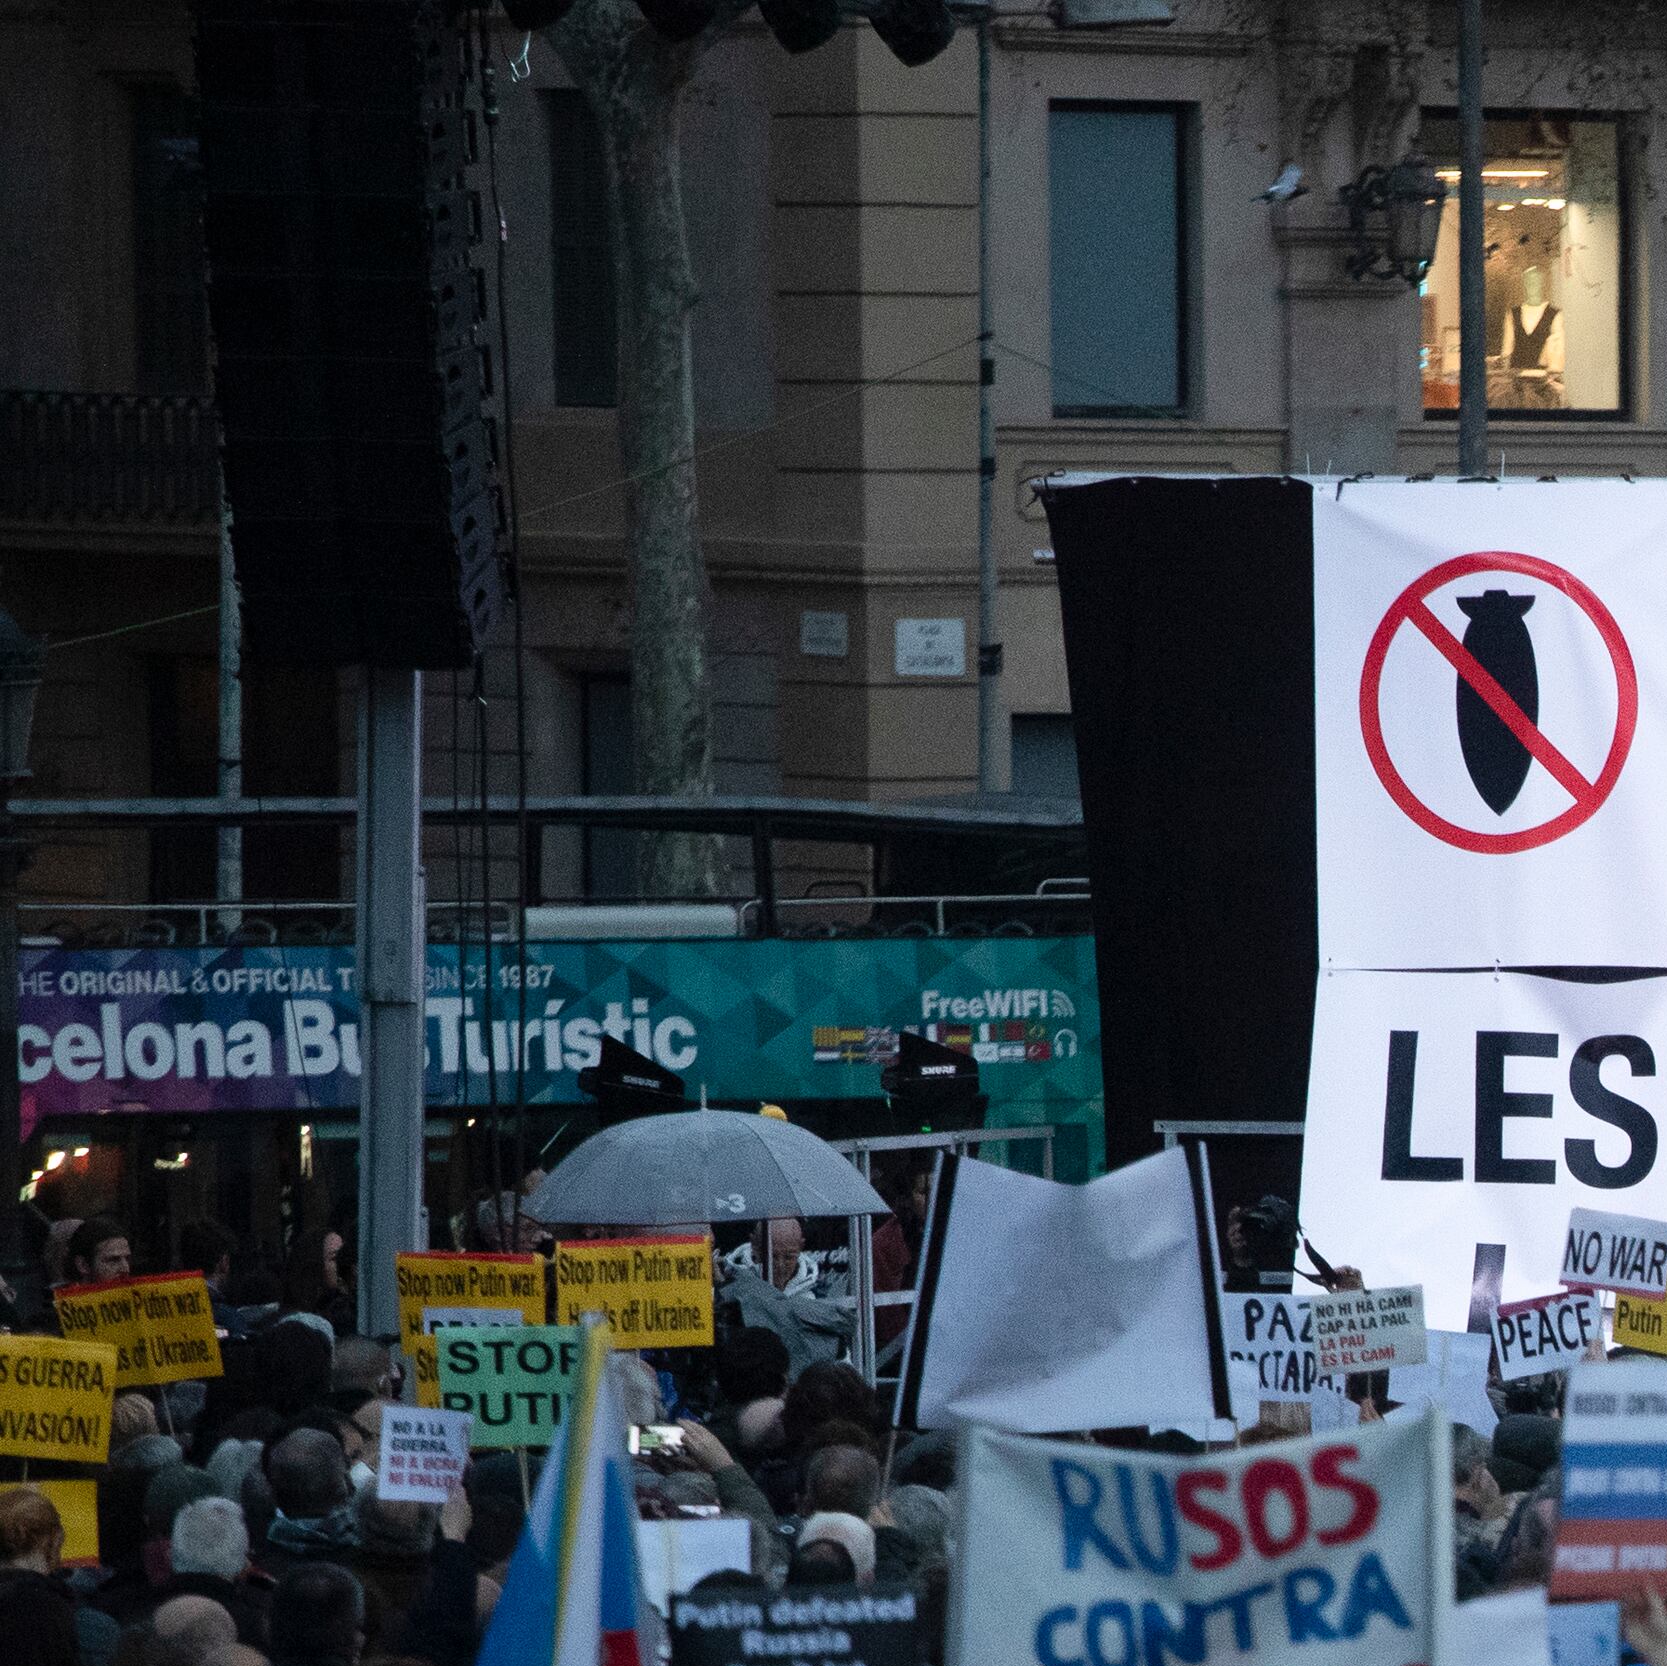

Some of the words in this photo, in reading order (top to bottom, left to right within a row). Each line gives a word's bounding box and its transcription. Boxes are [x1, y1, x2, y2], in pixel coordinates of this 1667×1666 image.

[18, 971, 54, 997] HE
[59, 970, 190, 996] ORIGINAL
[191, 968, 210, 995] &
[212, 967, 332, 993] OFFICIAL
[17, 1001, 273, 1083] celona
[282, 998, 430, 1078] Bu
[424, 996, 698, 1073] Turístic
[920, 1064, 957, 1076] SHURE
[1381, 1030, 1658, 1190] LES
[728, 1193, 746, 1214] 3
[557, 1252, 593, 1292] Stop
[599, 1260, 630, 1284] now
[633, 1249, 672, 1282] Putin
[674, 1256, 706, 1281] war.
[1562, 1227, 1601, 1276] NO
[399, 1268, 432, 1305] Stop
[435, 1274, 466, 1297] now
[468, 1265, 509, 1298] Putin
[510, 1272, 541, 1298] war.
[60, 1300, 98, 1335] Stop
[99, 1303, 132, 1326] now
[132, 1290, 171, 1321] Putin
[175, 1290, 207, 1316] war.
[620, 1301, 639, 1334] off
[642, 1299, 705, 1333] Ukraine.
[1315, 1305, 1336, 1319] NO
[1338, 1303, 1353, 1316] HI
[1356, 1300, 1375, 1314] HA
[1317, 1321, 1346, 1336] CAP
[1347, 1319, 1358, 1332] A
[1360, 1316, 1379, 1330] LA
[1616, 1300, 1663, 1336] Putin
[1319, 1337, 1336, 1351] LA
[1339, 1335, 1366, 1349] PAU
[1497, 1300, 1592, 1363] PEACE
[1230, 1350, 1343, 1394] CTAD.
[1341, 1351, 1357, 1365] EL
[0, 1406, 101, 1449] NVASIÓN!
[443, 1391, 563, 1426] PUTI
[1050, 1444, 1381, 1577] RUSOS
